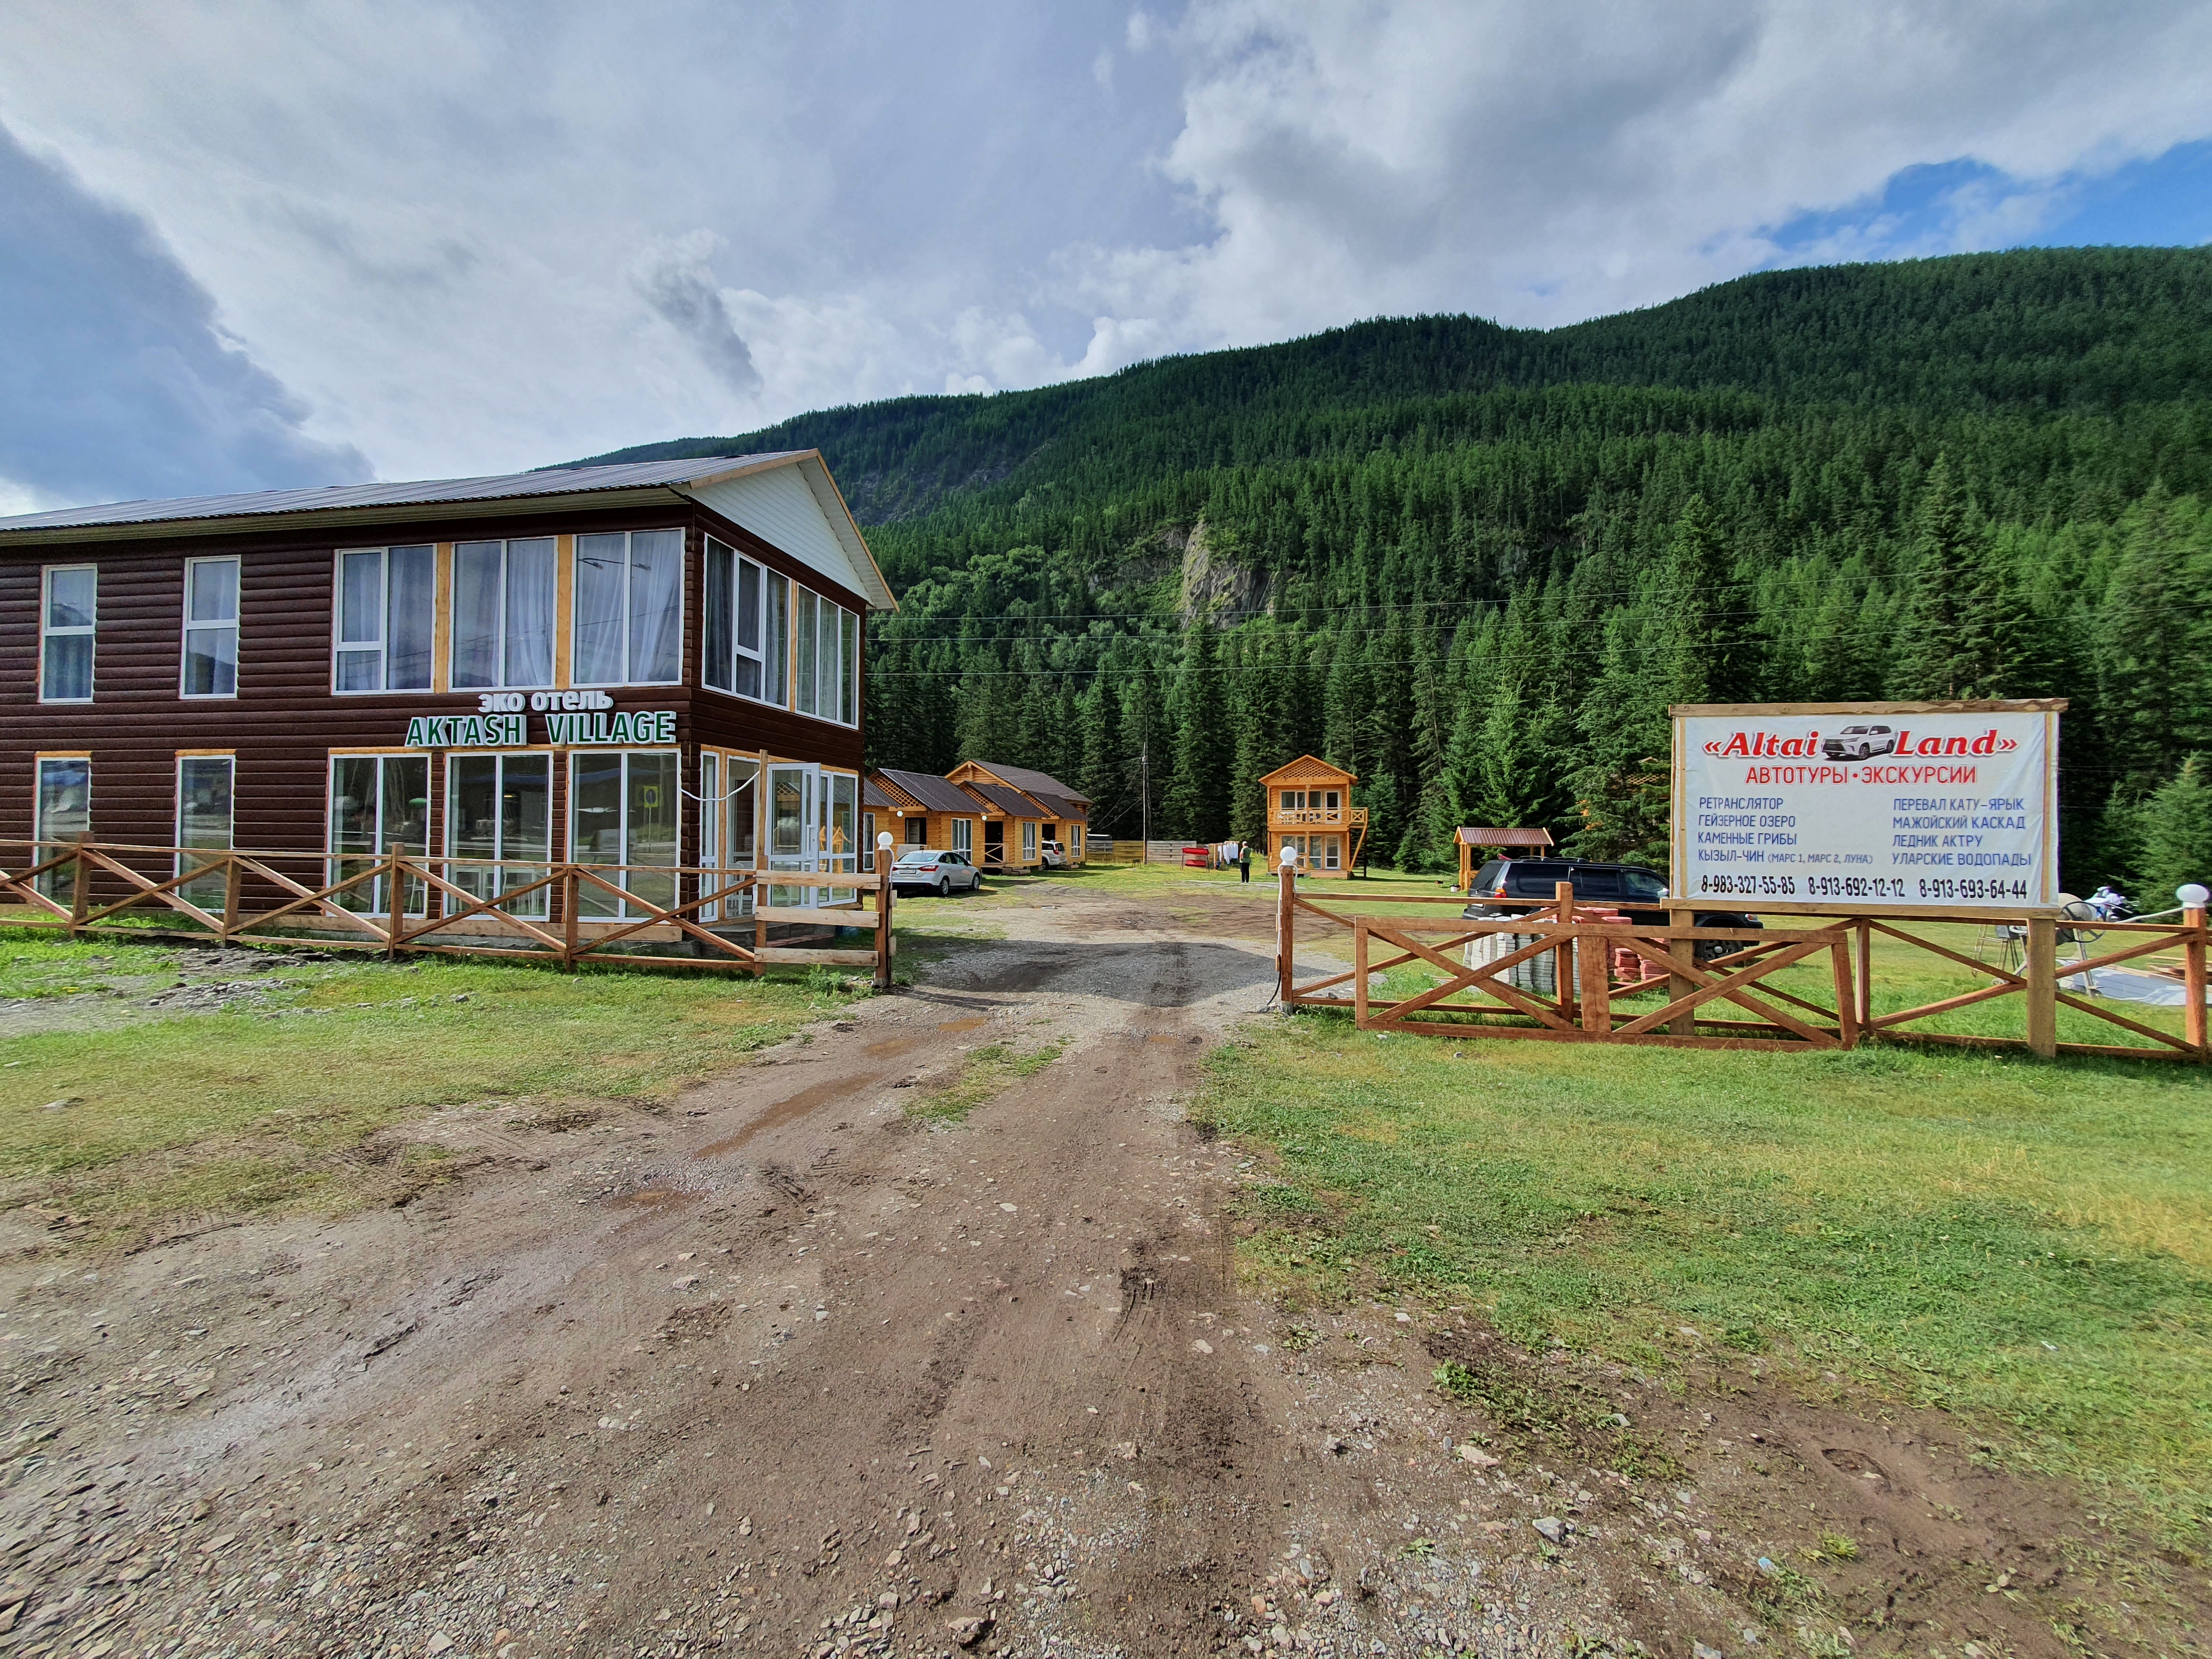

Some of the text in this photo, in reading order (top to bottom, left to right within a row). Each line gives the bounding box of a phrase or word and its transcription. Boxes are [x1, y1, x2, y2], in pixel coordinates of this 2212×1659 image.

[405, 711, 676, 746] AKTASH VILLAGE
[1699, 797, 1783, 810] РЕТРАНСЛЯТОР
[1893, 798, 1947, 811] ПЕРЕВАЛ
[1698, 813, 1795, 828] ГЕЙЗЕРНОЕ ОЗЕРО
[1892, 814, 2026, 830] МАЖОЙСКИЙ КАСКАД
[1698, 832, 1797, 845] КАМЕННЫЕ ГРИБЫ
[1892, 834, 1982, 848] ЛЕДНИК АКТРУ
[1698, 849, 1765, 863] КЫЗЫЛ-ЧИН
[1767, 853, 1796, 864] (МАРС
[1807, 854, 1830, 864] МАРС
[1891, 852, 2031, 867] УЛАРСКИЕ ВОДОПАДЫ
[1702, 875, 2027, 899] 8-983-327-55-85 8-913-692-12-12 8-913-693-64-44
